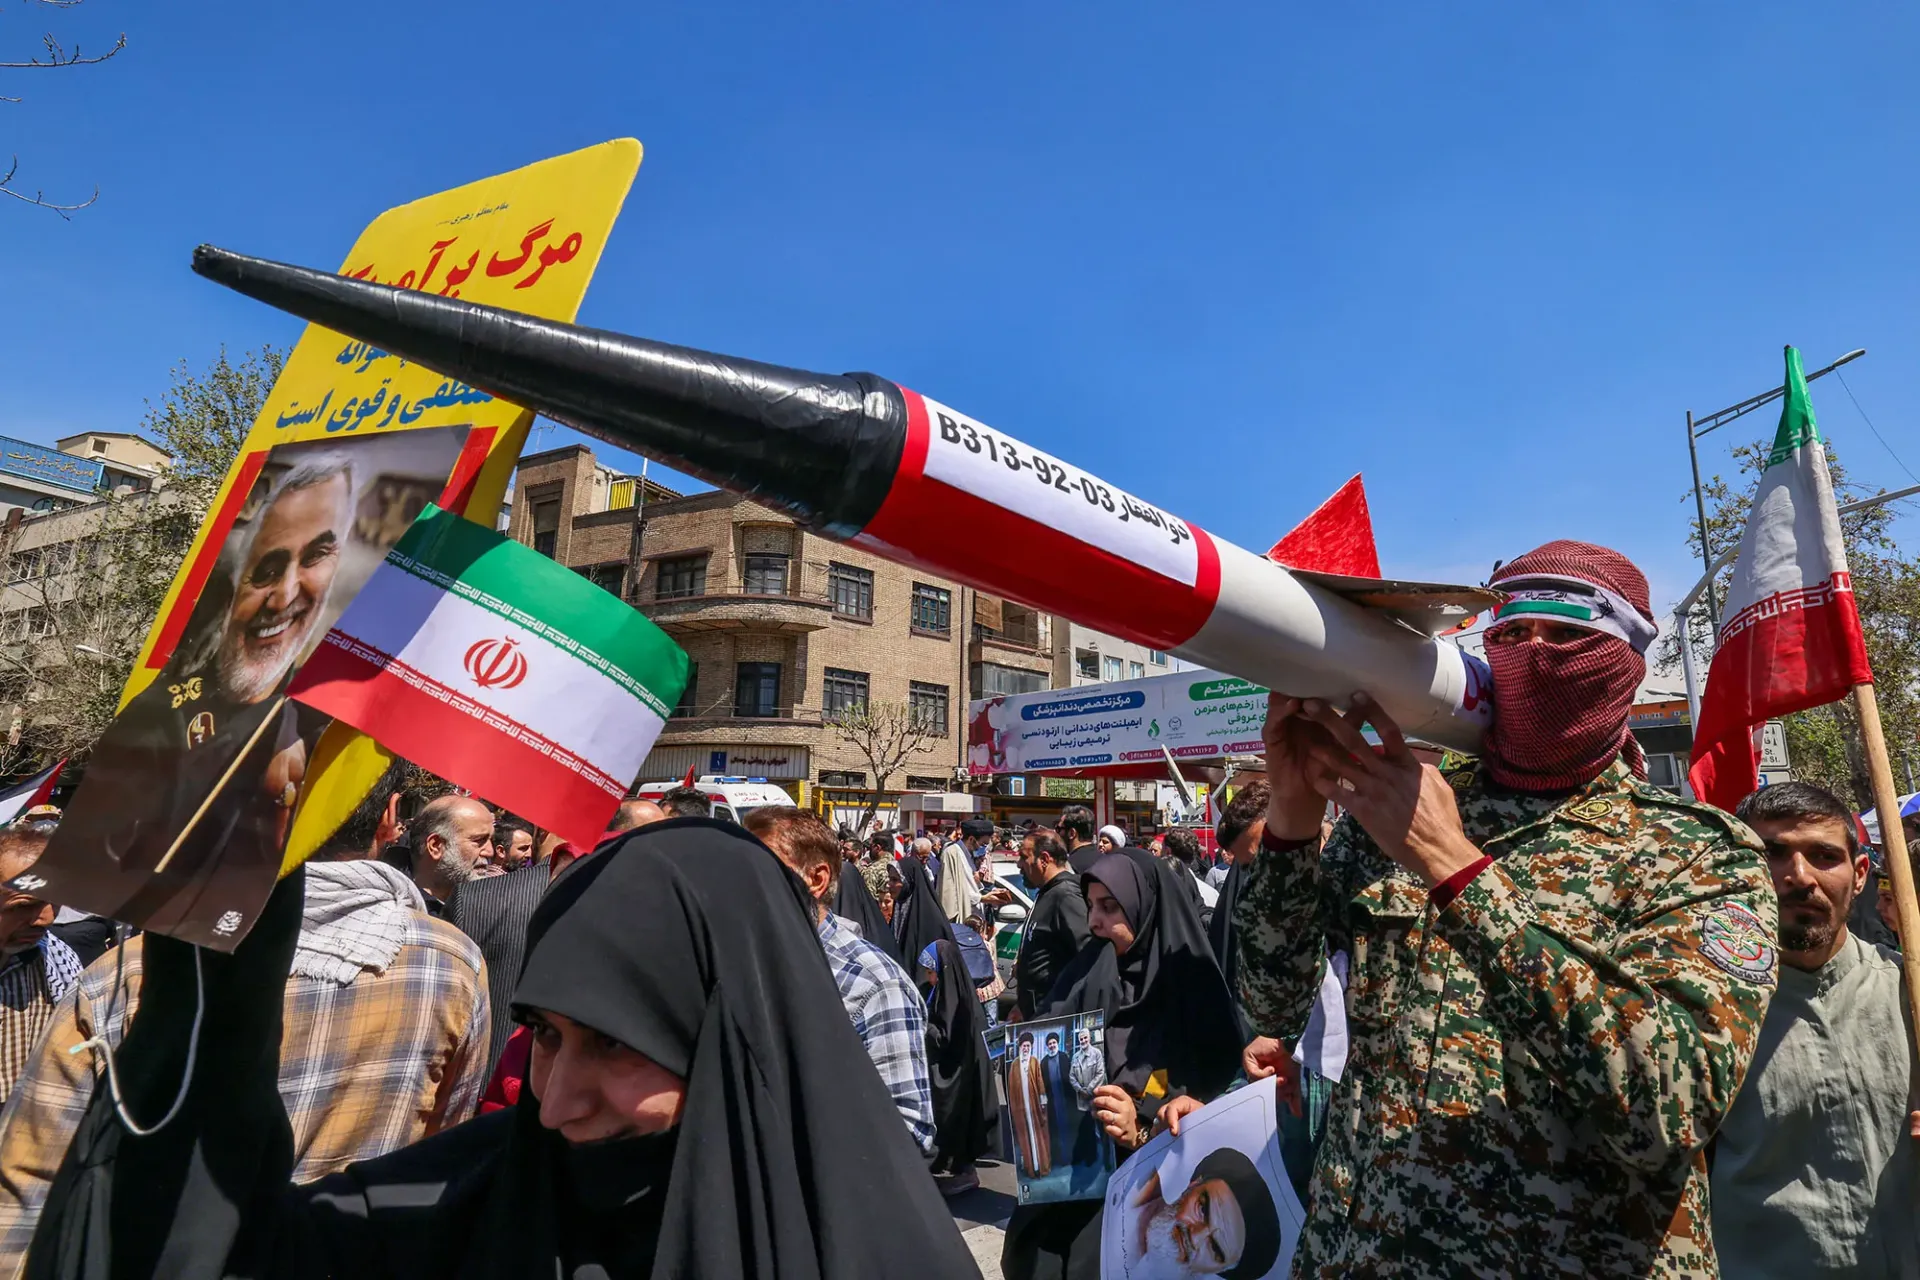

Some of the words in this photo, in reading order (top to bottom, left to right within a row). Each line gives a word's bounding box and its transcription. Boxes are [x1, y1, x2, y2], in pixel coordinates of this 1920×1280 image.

[440, 248, 481, 298] بر
[485, 217, 583, 290] مرگ
[275, 389, 333, 431] است
[326, 378, 391, 432] قوی
[380, 390, 401, 428] و
[936, 411, 1115, 514] B313-92-03
[1117, 494, 1190, 544] ذوالفقار
[1077, 697, 1112, 712] تخصصی
[1204, 682, 1228, 697] زخم
[1227, 681, 1257, 694] رمیم
[1065, 723, 1094, 735] دندانی
